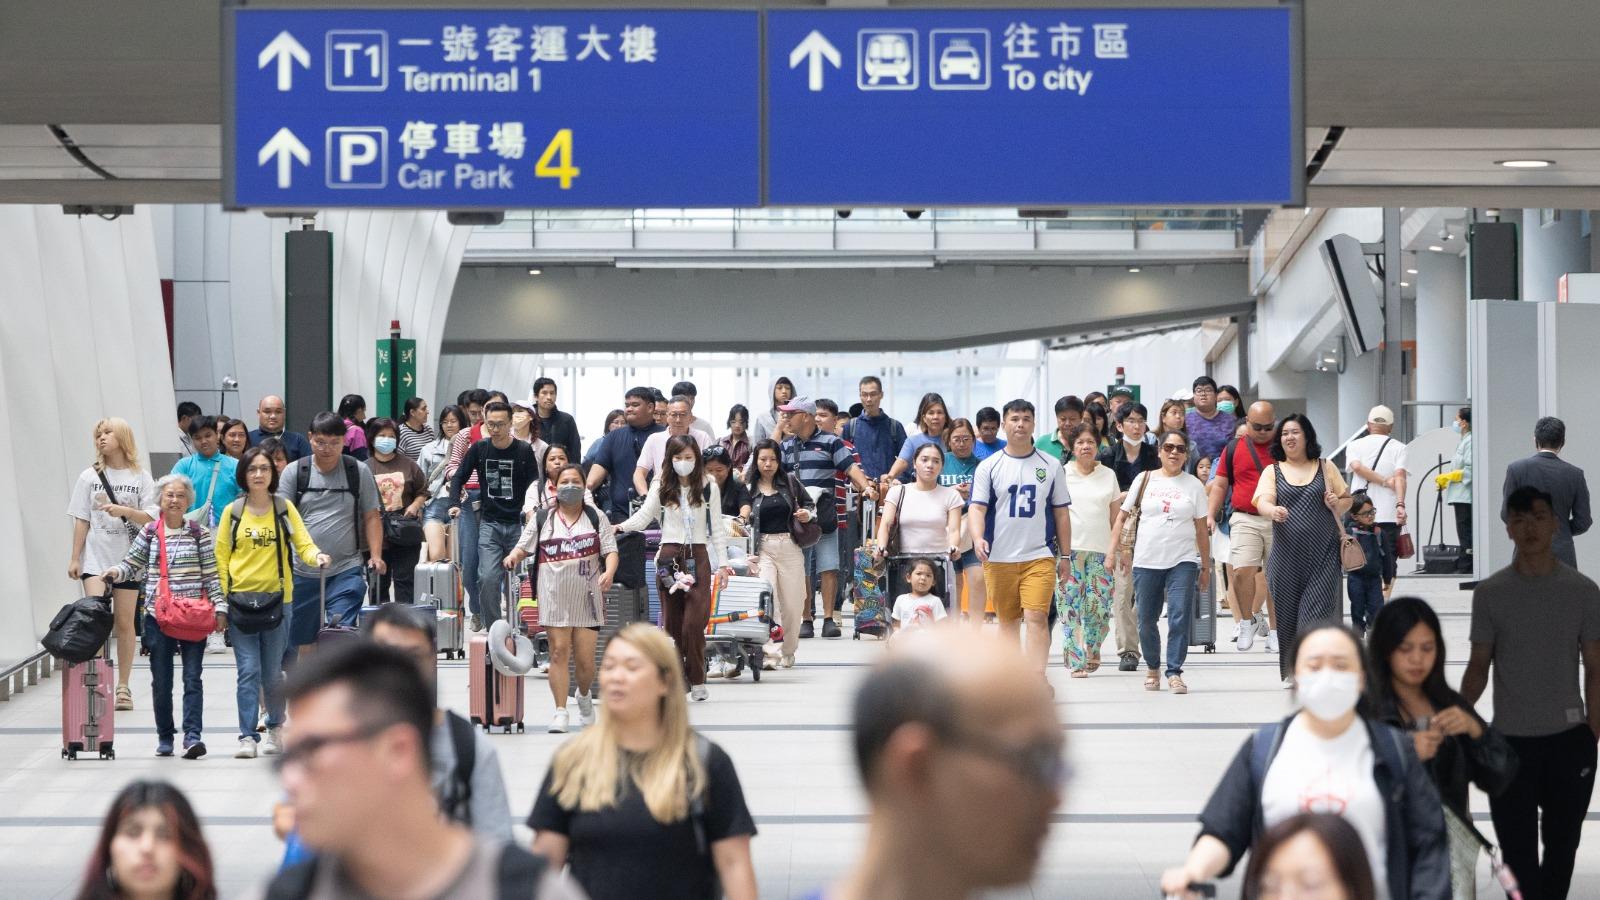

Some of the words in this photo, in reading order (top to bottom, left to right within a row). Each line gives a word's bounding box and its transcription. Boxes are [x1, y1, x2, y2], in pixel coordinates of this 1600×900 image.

[398, 24, 658, 63] 一號客運大樓
[1003, 23, 1129, 60] 往市區
[334, 42, 382, 78] T1
[398, 66, 519, 93] Terminal
[527, 67, 542, 93] 1
[1002, 64, 1036, 91] To
[1042, 64, 1093, 96] city
[339, 133, 378, 182] P
[398, 121, 527, 160] 停車場
[398, 163, 446, 189] Car
[454, 163, 513, 190] Park
[534, 128, 581, 190] 4
[1008, 484, 1037, 518] 13
